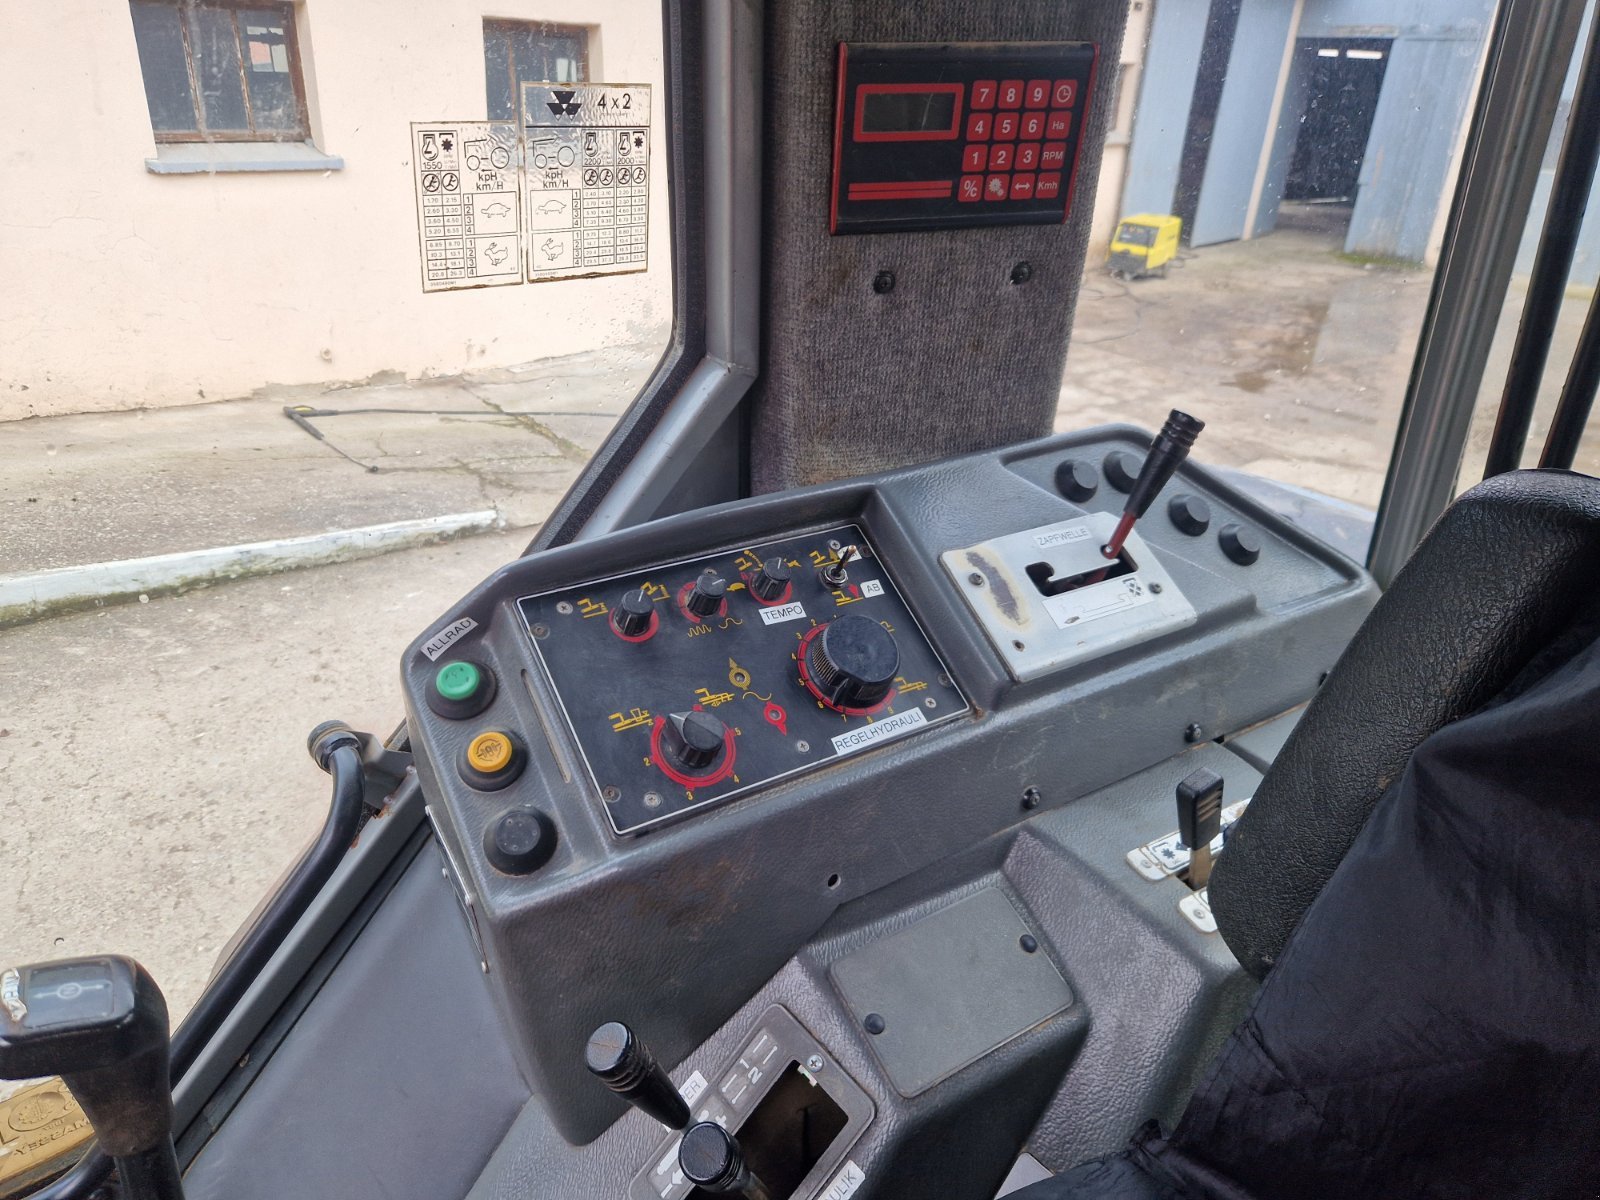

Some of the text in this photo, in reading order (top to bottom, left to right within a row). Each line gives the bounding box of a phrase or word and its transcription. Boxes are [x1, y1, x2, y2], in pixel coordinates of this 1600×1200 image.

[980, 88, 1042, 102] 7 8 9
[597, 93, 606, 109] 4
[622, 93, 631, 109] 2
[975, 120, 1064, 134] 4 5 6 Ha
[973, 150, 1064, 165] 1 2 3 RPM
[479, 172, 497, 181] kpH
[546, 171, 563, 180] kpH
[476, 181, 503, 190] km/H
[543, 180, 568, 188] km/H
[1038, 181, 1058, 190] Kmh
[1037, 528, 1088, 546] ZAPFWELLE
[867, 583, 880, 593] AB
[763, 605, 803, 621] TEMPO
[426, 618, 472, 656] ALLRAD
[734, 727, 741, 735] 5
[834, 712, 922, 751] REGELHYDRAULI
[643, 757, 650, 766] 2
[733, 774, 739, 783] 4
[686, 791, 693, 800] 3
